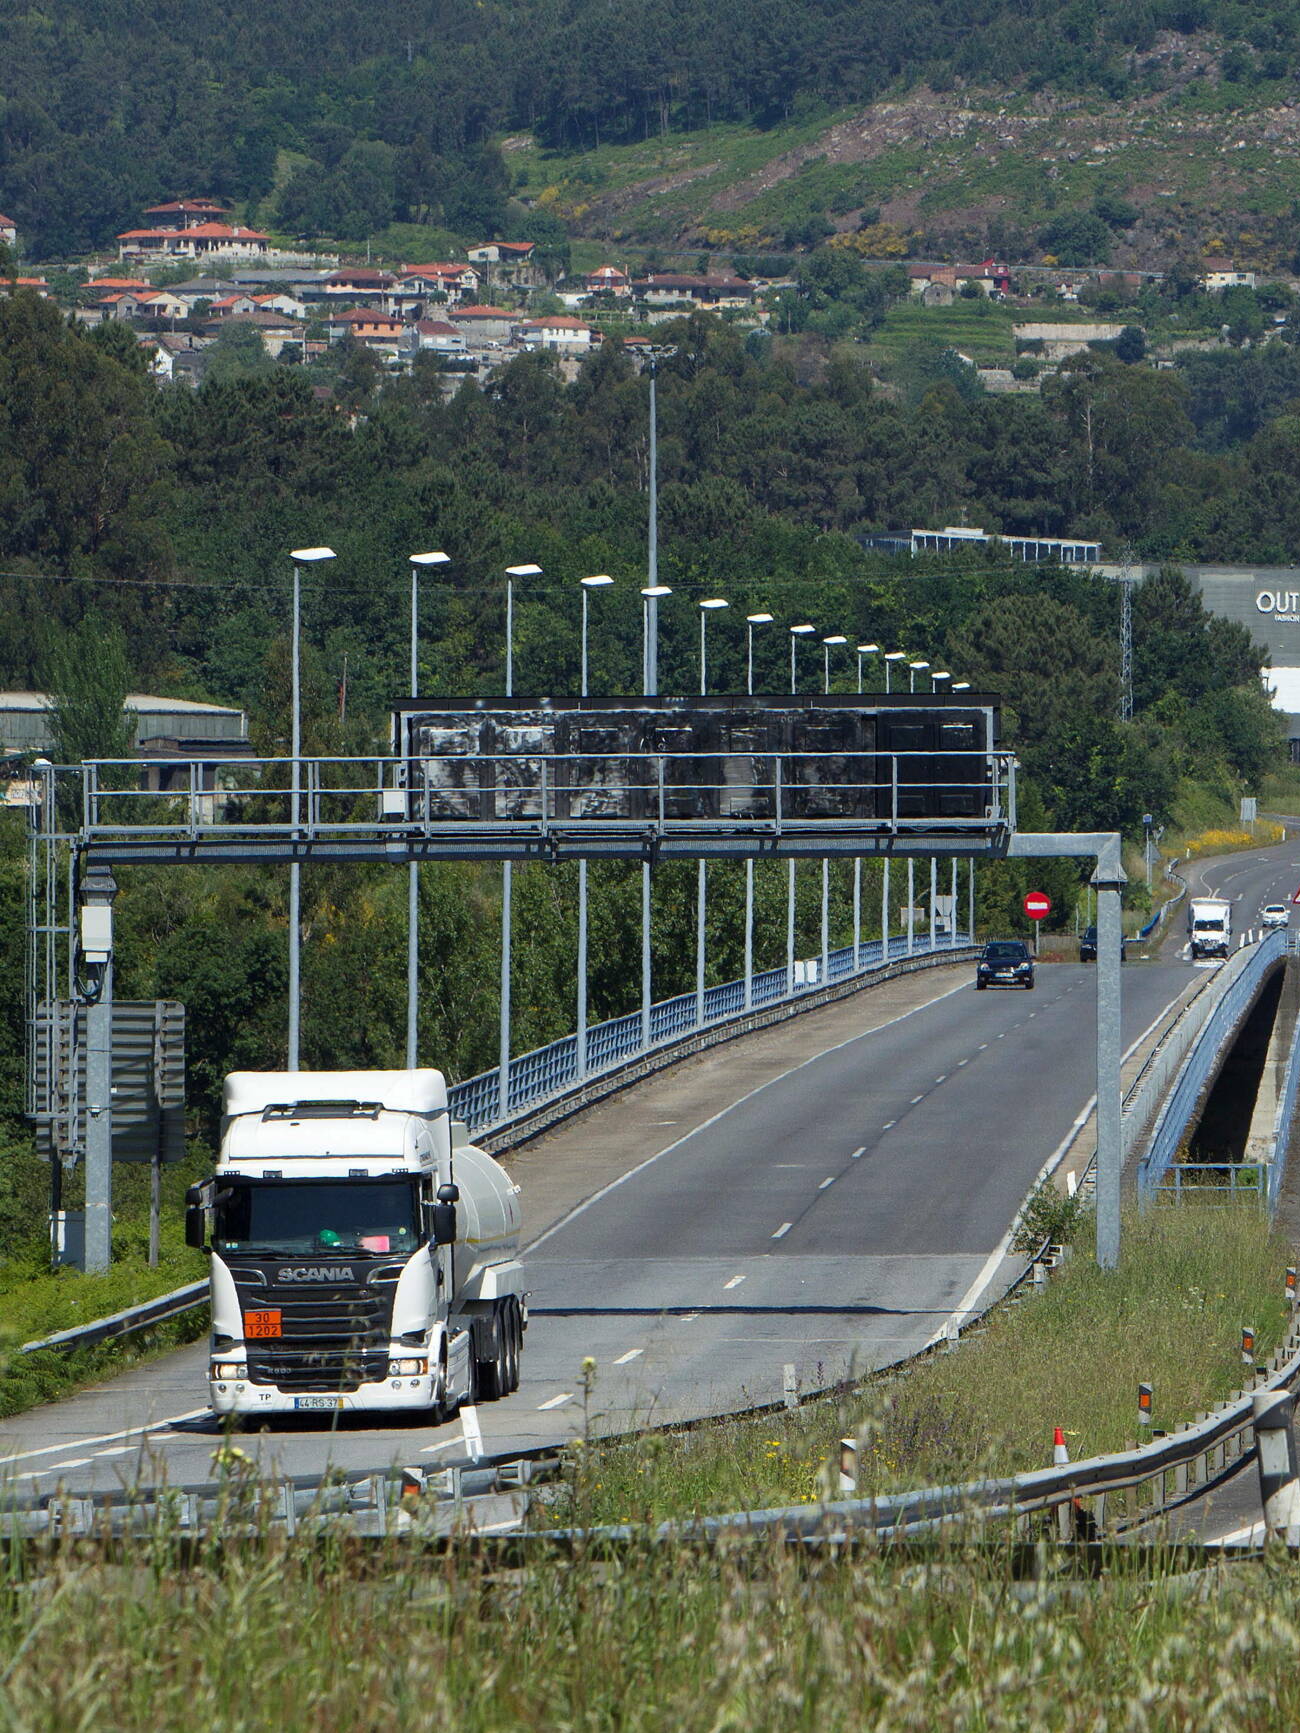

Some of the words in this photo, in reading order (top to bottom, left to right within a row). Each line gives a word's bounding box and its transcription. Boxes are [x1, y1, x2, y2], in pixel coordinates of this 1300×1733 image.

[278, 1267, 355, 1281] SCANIA
[255, 1313, 270, 1323] 30
[249, 1326, 278, 1336] 1202
